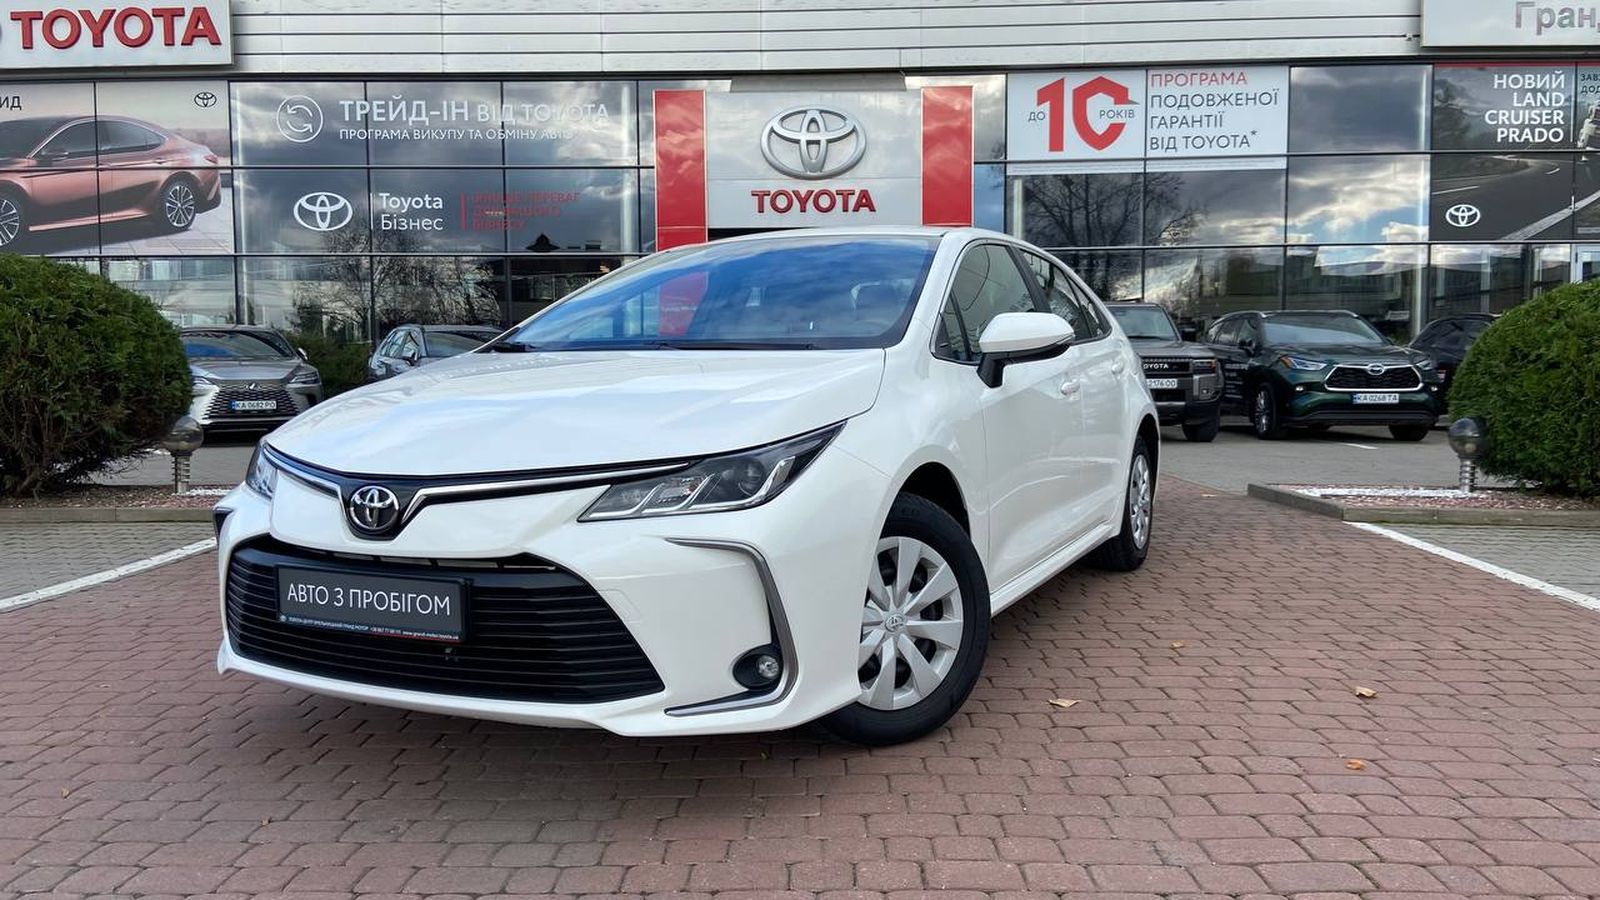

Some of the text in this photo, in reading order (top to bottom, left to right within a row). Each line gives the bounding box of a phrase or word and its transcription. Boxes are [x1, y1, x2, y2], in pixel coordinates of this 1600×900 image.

[1515, 1, 1600, 35] Гран
[11, 7, 221, 49] TOYOTA
[1151, 71, 1248, 89] ПРОГРАМА
[1493, 70, 1565, 89] НОВИЙ
[1580, 73, 1600, 81] ЗАВ
[1150, 88, 1280, 111] ПОДОВЖЕНОЇ
[1513, 92, 1565, 107] LAND
[339, 94, 609, 126] ТРЕЙД-ІН ВІД TOYOTA
[1028, 111, 1046, 123] ДО
[1099, 109, 1136, 120] РОКІВ
[1485, 109, 1565, 125] CRUISER
[1150, 110, 1224, 130] ГАРАНТІЇ
[339, 129, 411, 140] ПРОГРАМА
[413, 129, 465, 140] ВИКУПУ
[468, 129, 483, 140] ТА
[485, 129, 538, 140] ОБМІНУ
[1497, 127, 1564, 143] PRADO
[1150, 136, 1178, 153] ВІД
[379, 193, 443, 211] Toyota
[751, 189, 876, 213] TOYOTA
[381, 211, 444, 230] Бізнес
[287, 583, 451, 615] АВТО З ПРОБІГОМ
